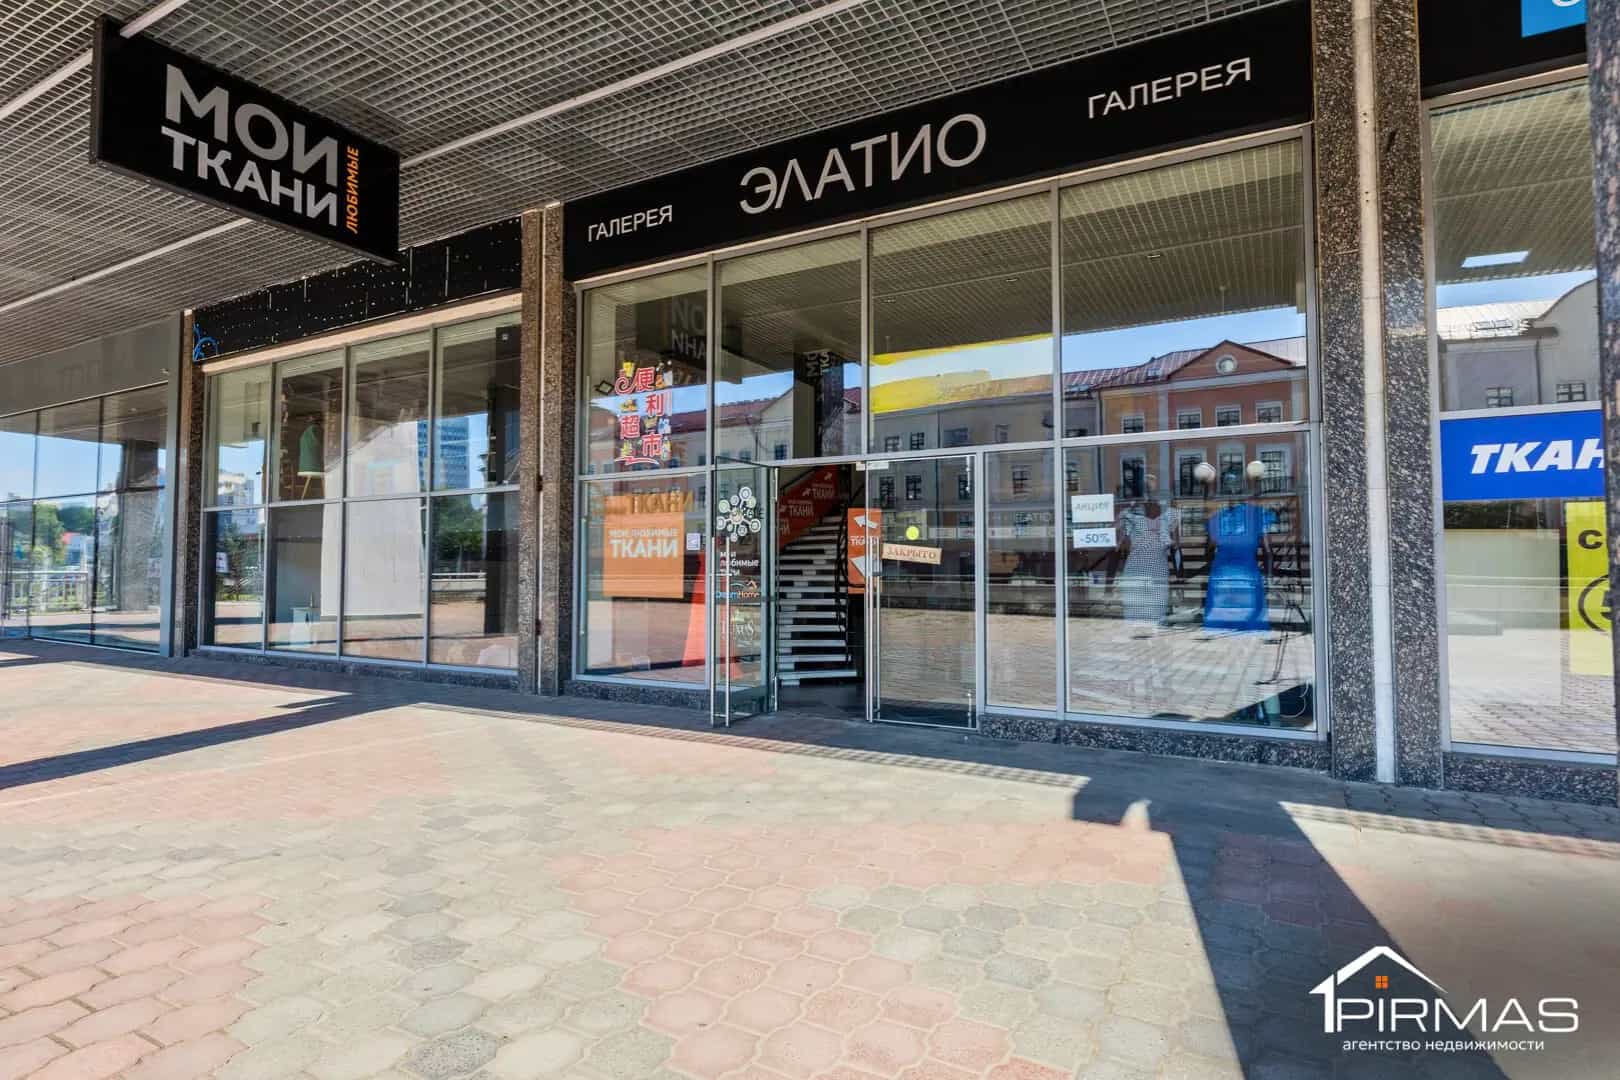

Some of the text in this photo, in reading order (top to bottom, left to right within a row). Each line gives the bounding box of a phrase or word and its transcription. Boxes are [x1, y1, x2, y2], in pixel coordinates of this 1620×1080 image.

[1088, 57, 1251, 119] ГАЛЕРЕЯ
[165, 64, 338, 187] МОИ
[161, 126, 338, 226] ТКАНИ
[345, 145, 359, 234] ЛЮБИМЫЕ
[739, 113, 987, 214] ЭЛАТИО
[588, 205, 673, 242] ГАЛЕРЕЯ
[1471, 439, 1605, 475] ТКАН
[609, 538, 679, 559] ТКАНИ
[1079, 533, 1111, 545] -50%
